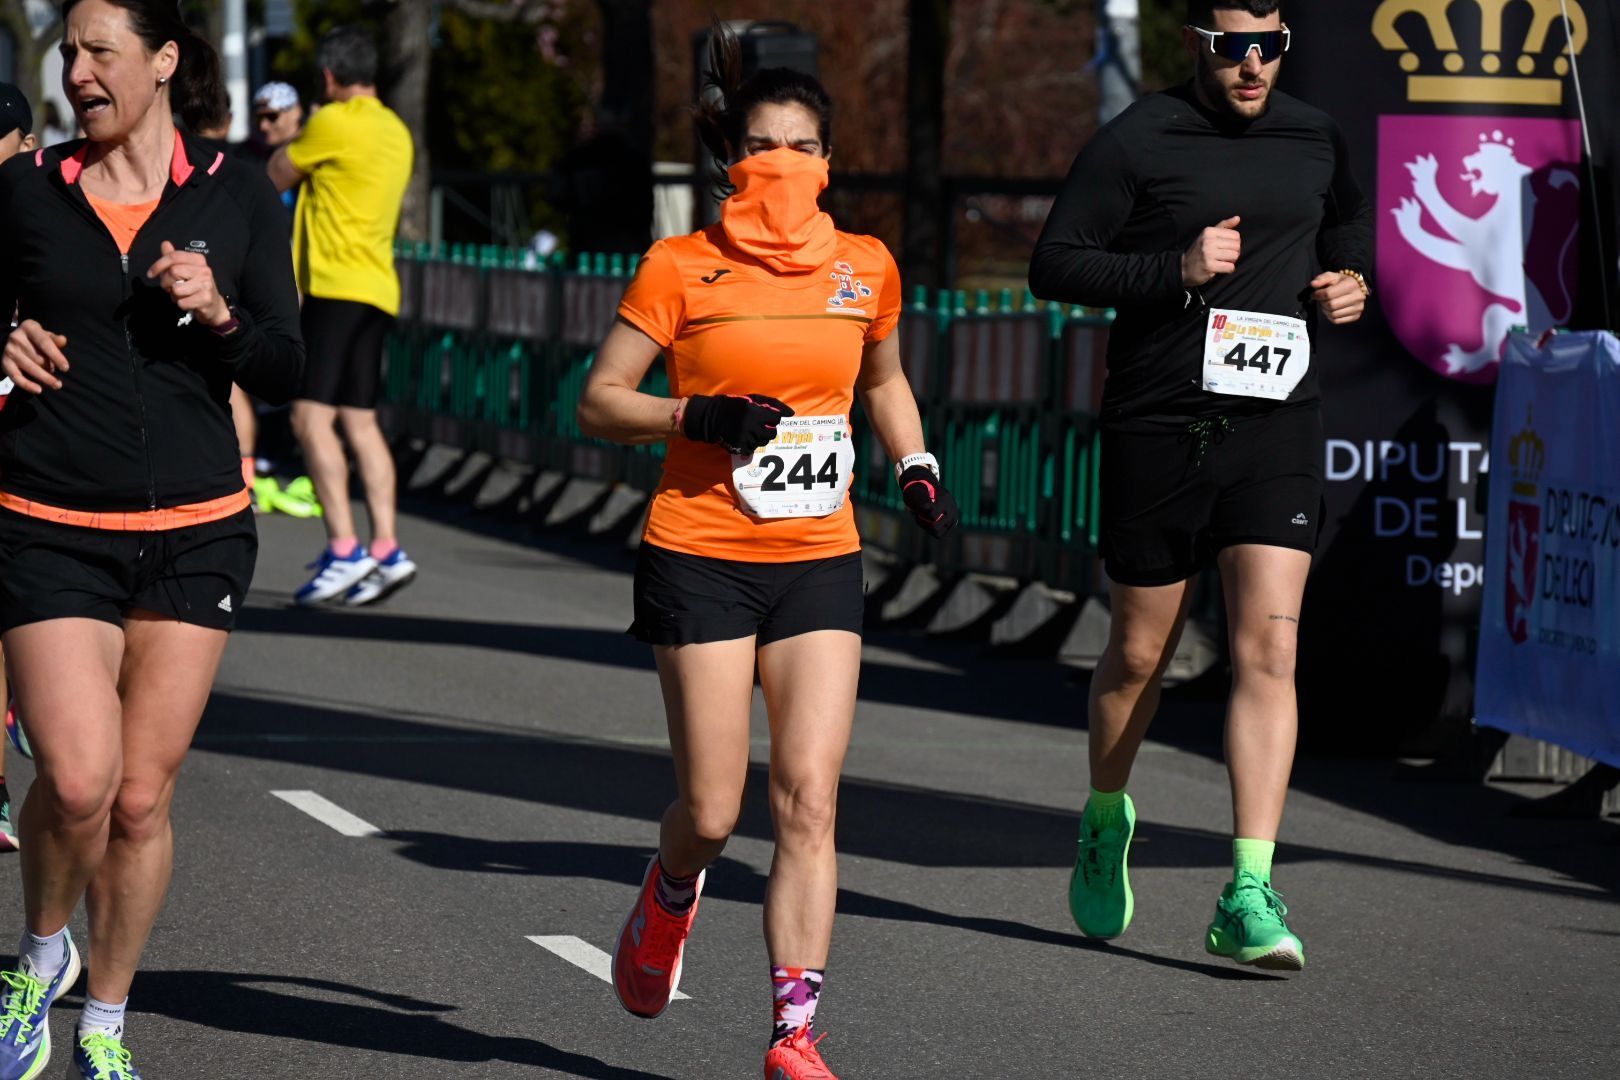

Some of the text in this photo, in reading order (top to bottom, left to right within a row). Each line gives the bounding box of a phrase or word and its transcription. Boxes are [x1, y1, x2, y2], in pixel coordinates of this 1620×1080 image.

[1212, 314, 1228, 330] 10
[1223, 342, 1292, 376] 447
[758, 452, 839, 491] 244
[1373, 496, 1440, 539] DE
